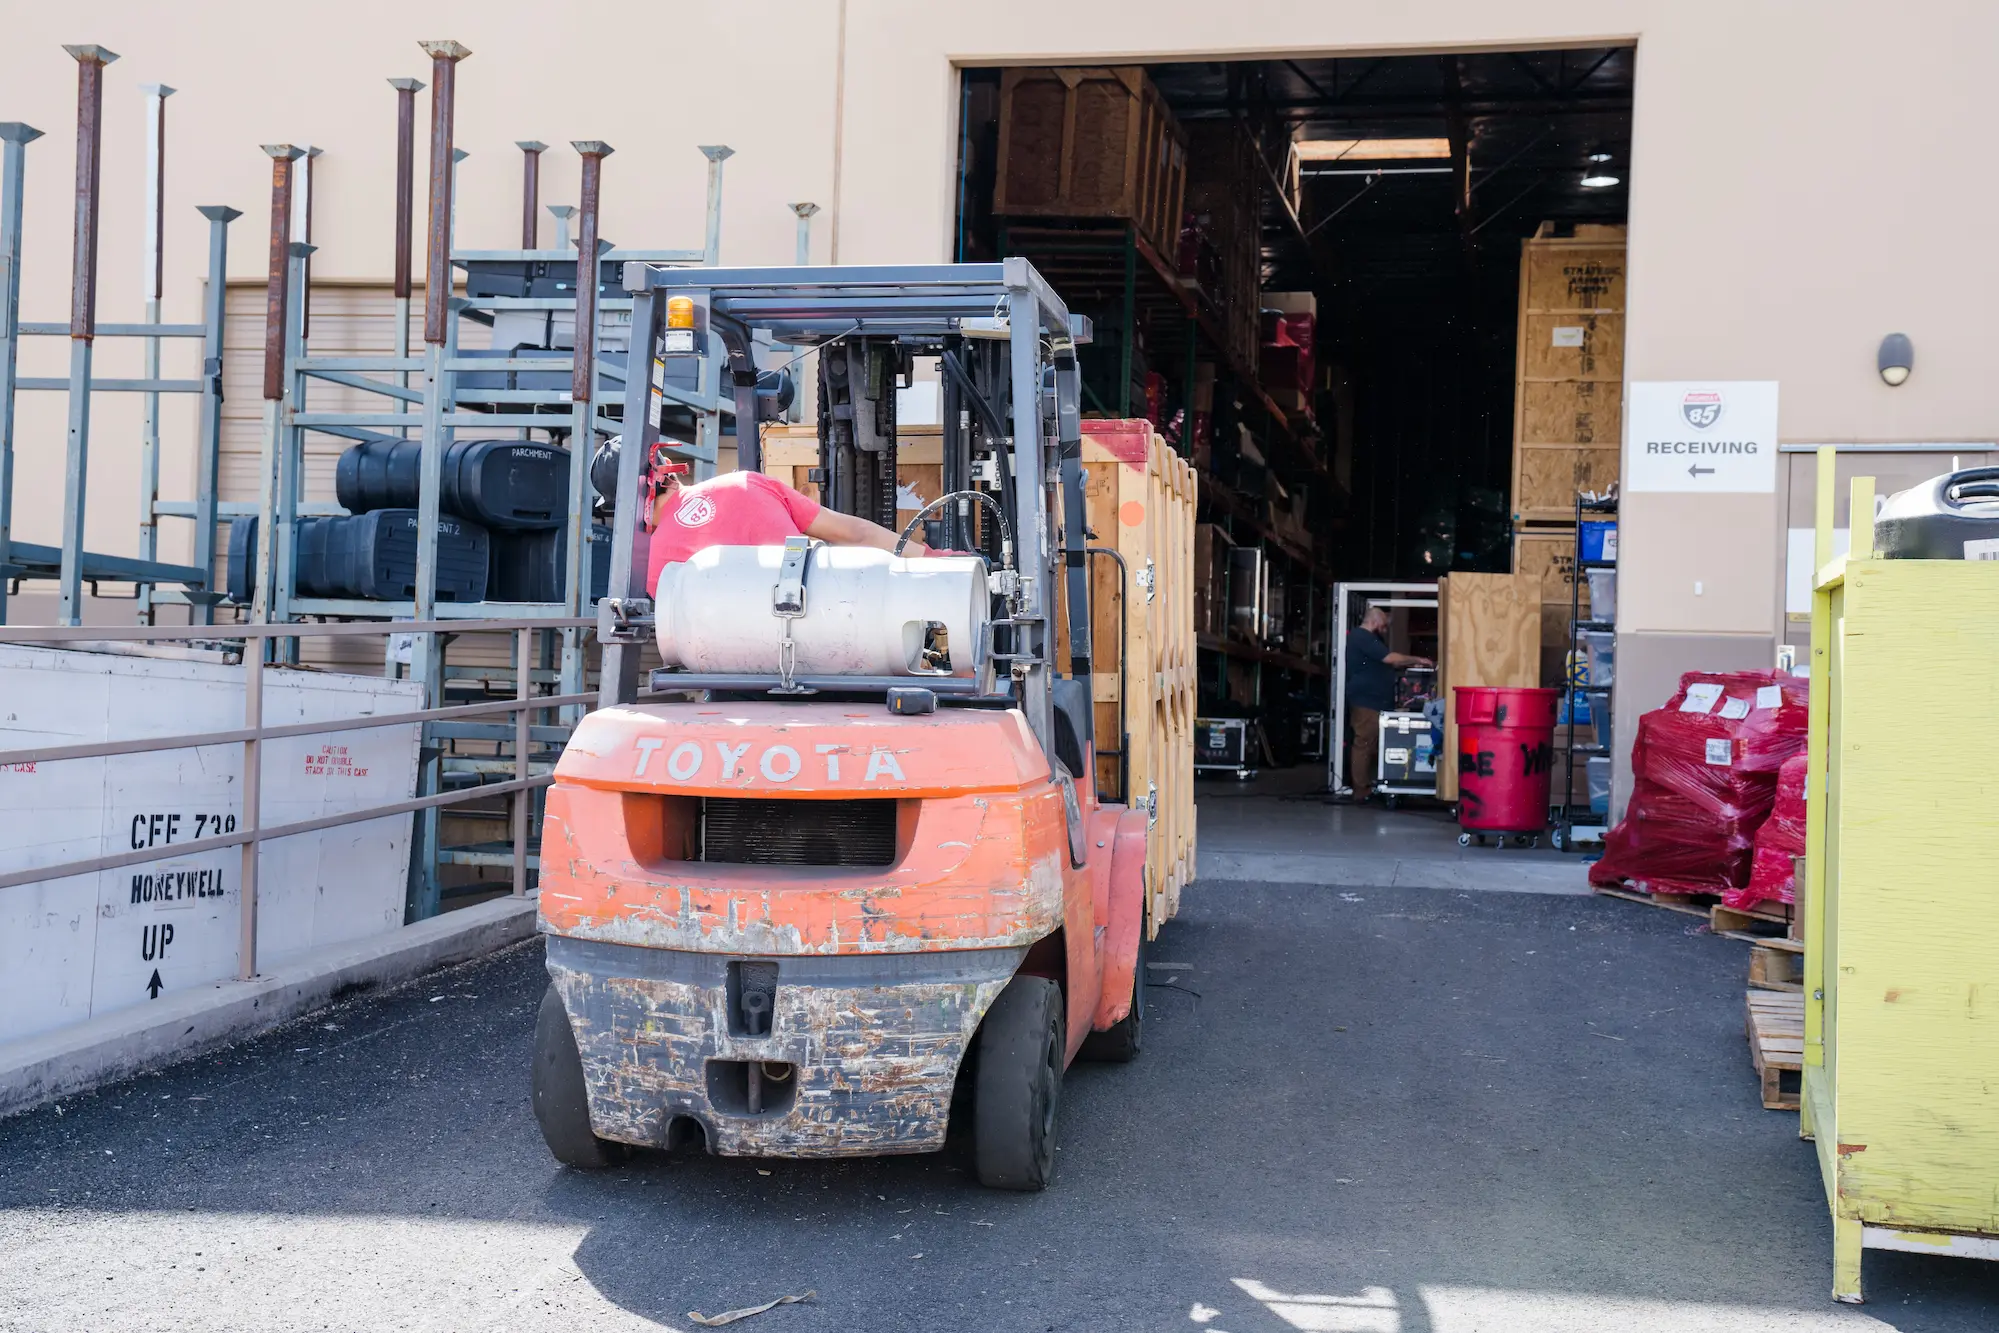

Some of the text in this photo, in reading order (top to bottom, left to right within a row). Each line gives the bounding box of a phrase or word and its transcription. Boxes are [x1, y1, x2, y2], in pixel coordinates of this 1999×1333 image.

[1689, 405, 1719, 425] 85
[512, 448, 552, 460] PARCHMENT
[1647, 441, 1758, 454] RECEIVING
[691, 503, 707, 522] 85
[454, 525, 460, 535] 2
[322, 745, 348, 755] CAUTION
[306, 755, 314, 764] DO
[317, 756, 328, 764] NOT
[634, 737, 906, 783] TOYOTA
[305, 766, 324, 775] STACK
[338, 767, 351, 777] THIS
[354, 768, 368, 777] CASE
[131, 814, 181, 849] CFF
[131, 868, 224, 904] HONEYWELL
[142, 923, 174, 961] UP
